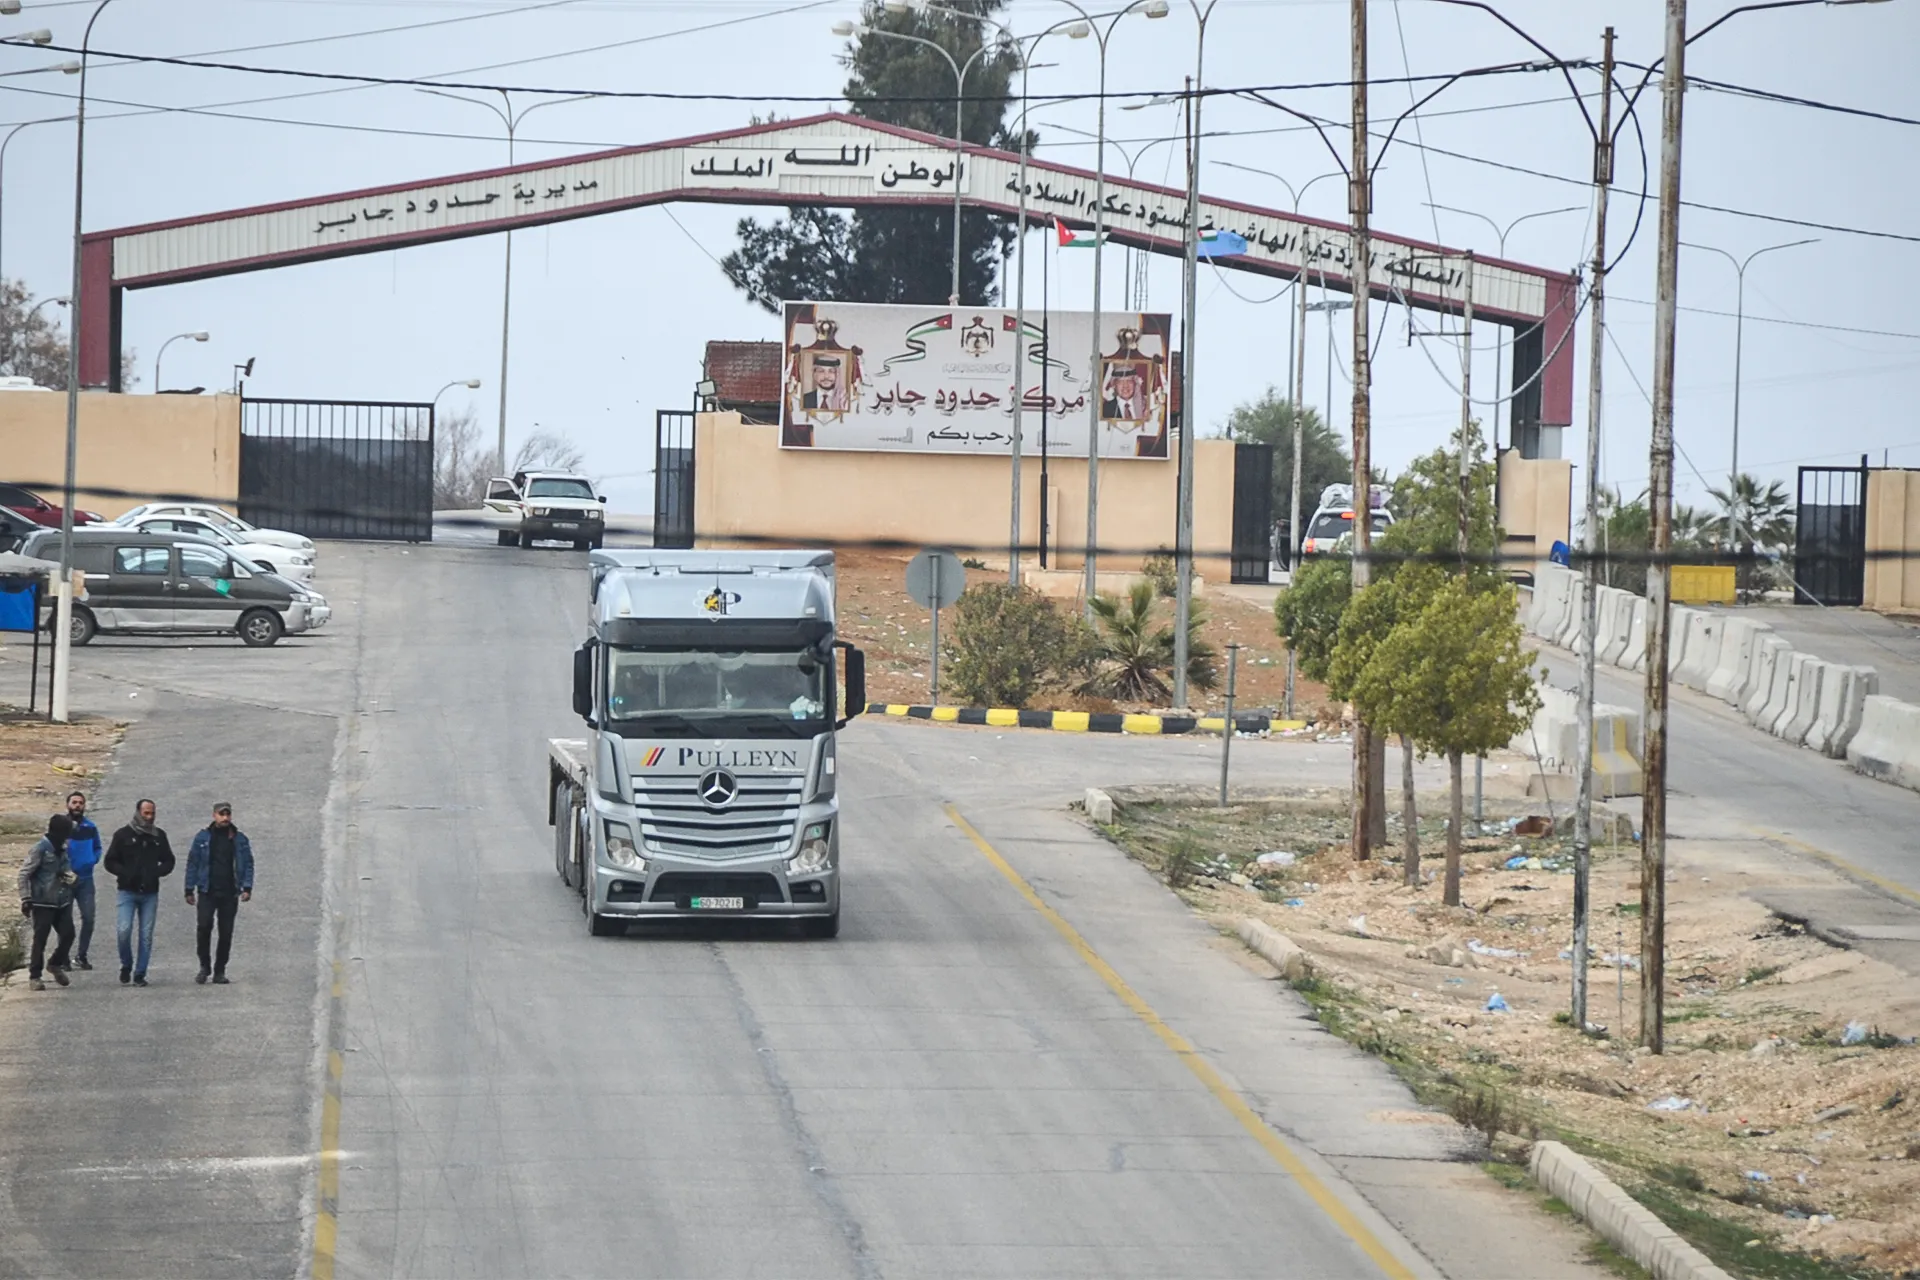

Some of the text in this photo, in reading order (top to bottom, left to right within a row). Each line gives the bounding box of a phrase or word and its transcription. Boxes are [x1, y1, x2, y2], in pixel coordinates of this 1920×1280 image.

[690, 144, 964, 187] الوطن الله الملك
[313, 180, 598, 233] مديرية حدود جابر
[1005, 172, 1085, 207] السلامة
[1087, 194, 1192, 229] ستودعكم
[1198, 215, 1297, 254] الهاشة
[1384, 252, 1464, 288] المملكة
[871, 381, 1084, 416] مركز حدود جابر
[927, 425, 970, 445] بكم
[678, 747, 798, 767] PULLEYN
